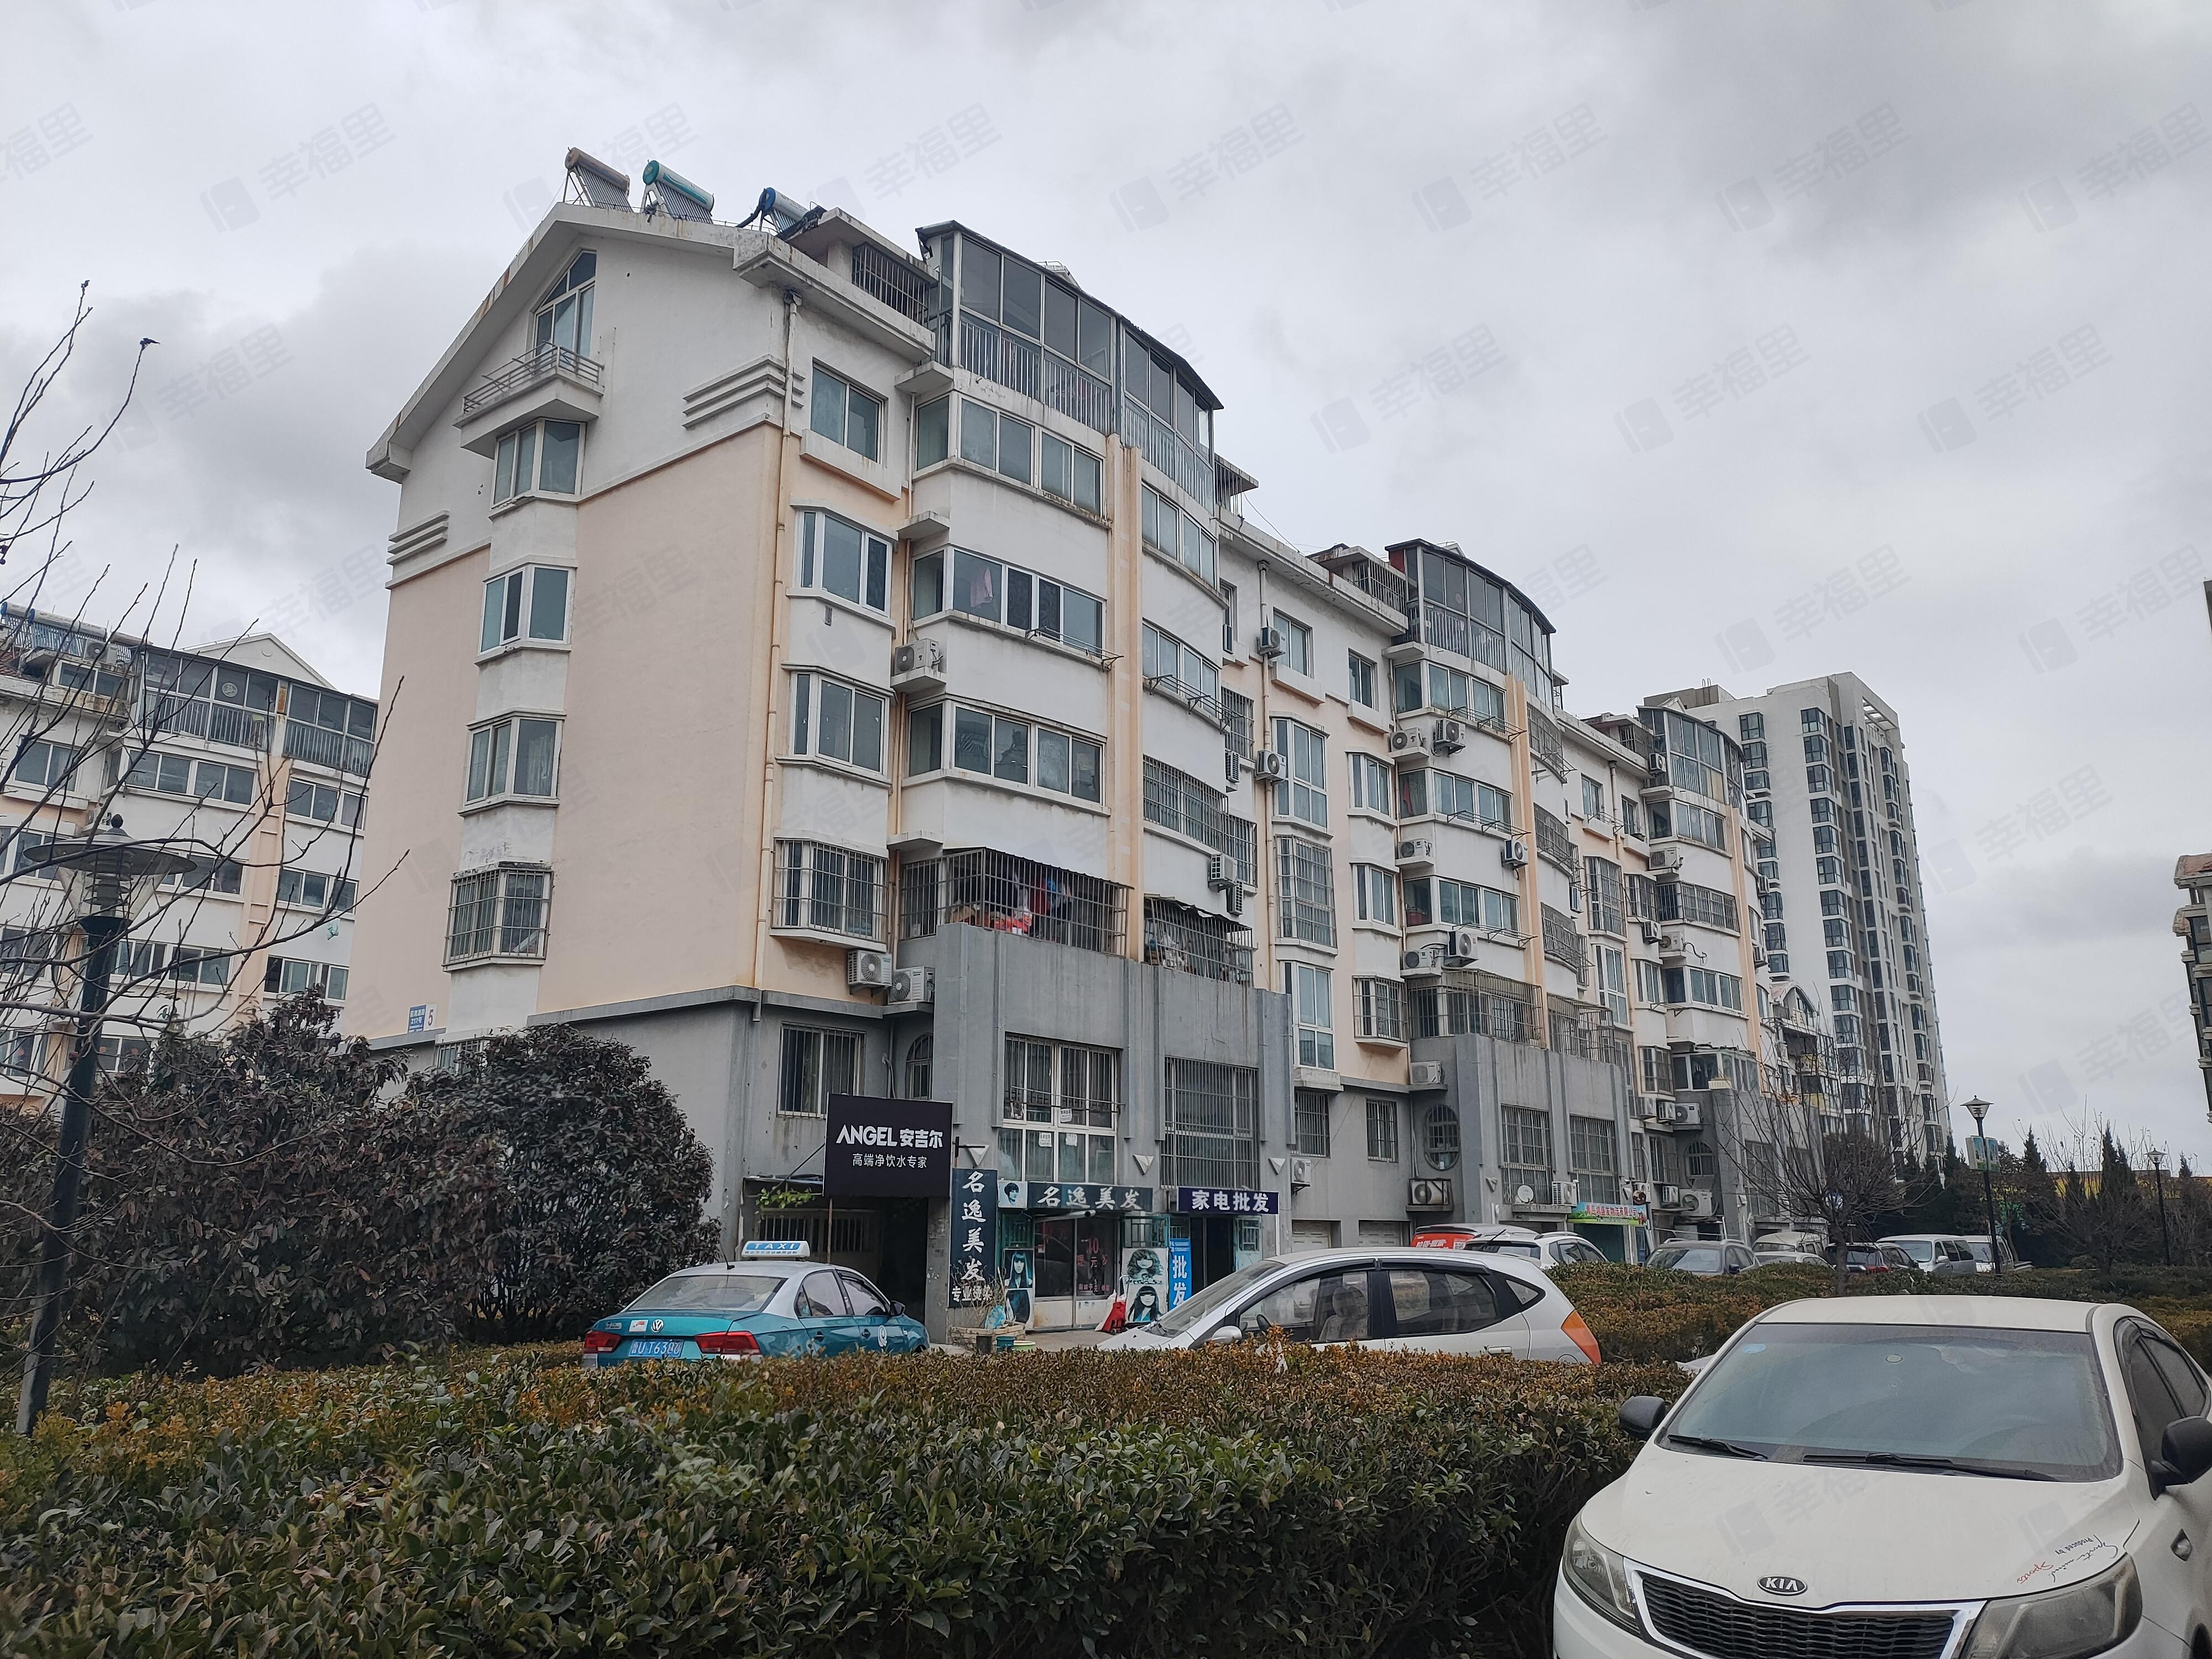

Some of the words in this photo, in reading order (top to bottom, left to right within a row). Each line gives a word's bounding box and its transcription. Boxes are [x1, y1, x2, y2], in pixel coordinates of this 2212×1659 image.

[427, 1009, 434, 1026] 5
[836, 1124, 898, 1147] ANGEL
[899, 1128, 943, 1149] 安吉尔
[852, 1152, 927, 1168] 高端净饮水专家
[1037, 1186, 1143, 1211] 名逸美发
[1191, 1190, 1270, 1213] 家电批发
[961, 1171, 987, 1281] 名逸美发
[1172, 1255, 1188, 1307] 批发
[2065, 1537, 2094, 1551] Produced
[2017, 1561, 2053, 1584] Sports
[1766, 1577, 1798, 1592] KIA
